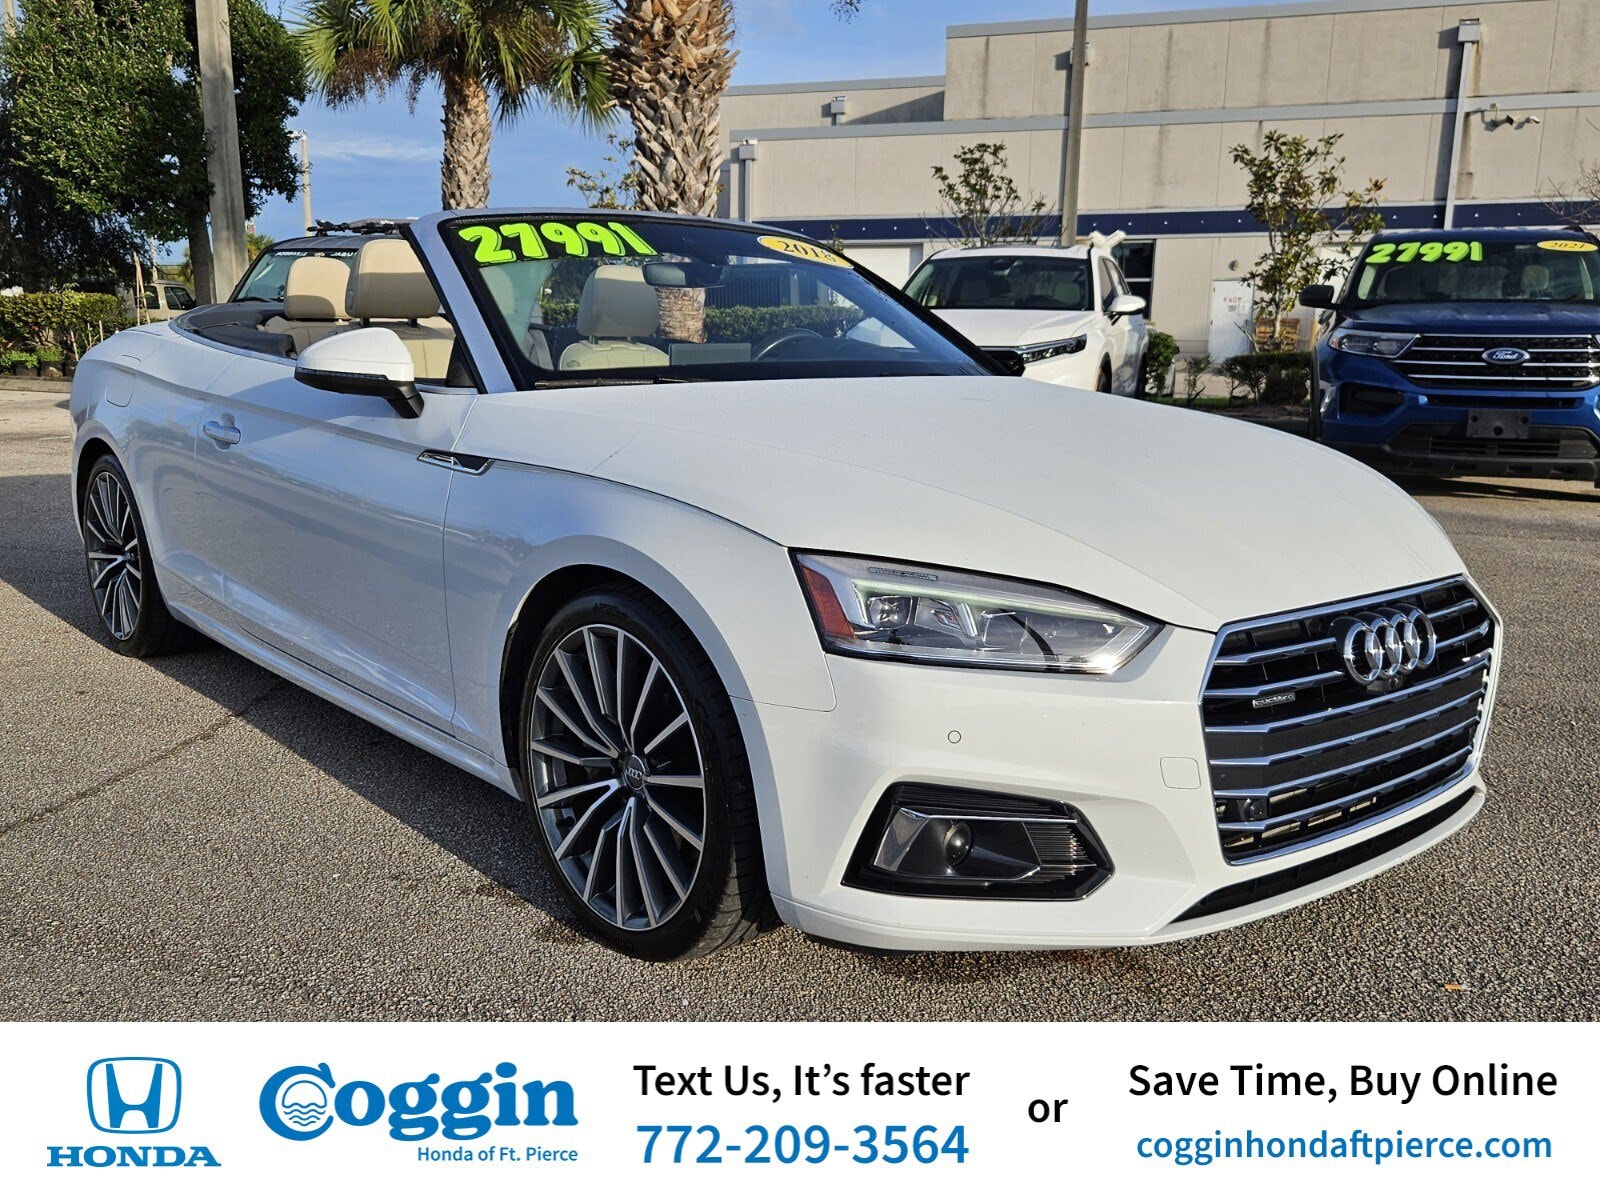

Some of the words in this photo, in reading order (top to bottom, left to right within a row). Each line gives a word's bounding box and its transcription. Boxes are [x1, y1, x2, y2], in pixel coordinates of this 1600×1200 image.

[458, 222, 658, 263] 27991
[777, 240, 837, 262] 2018
[1365, 241, 1483, 263] 27991
[1492, 350, 1519, 360] Ford
